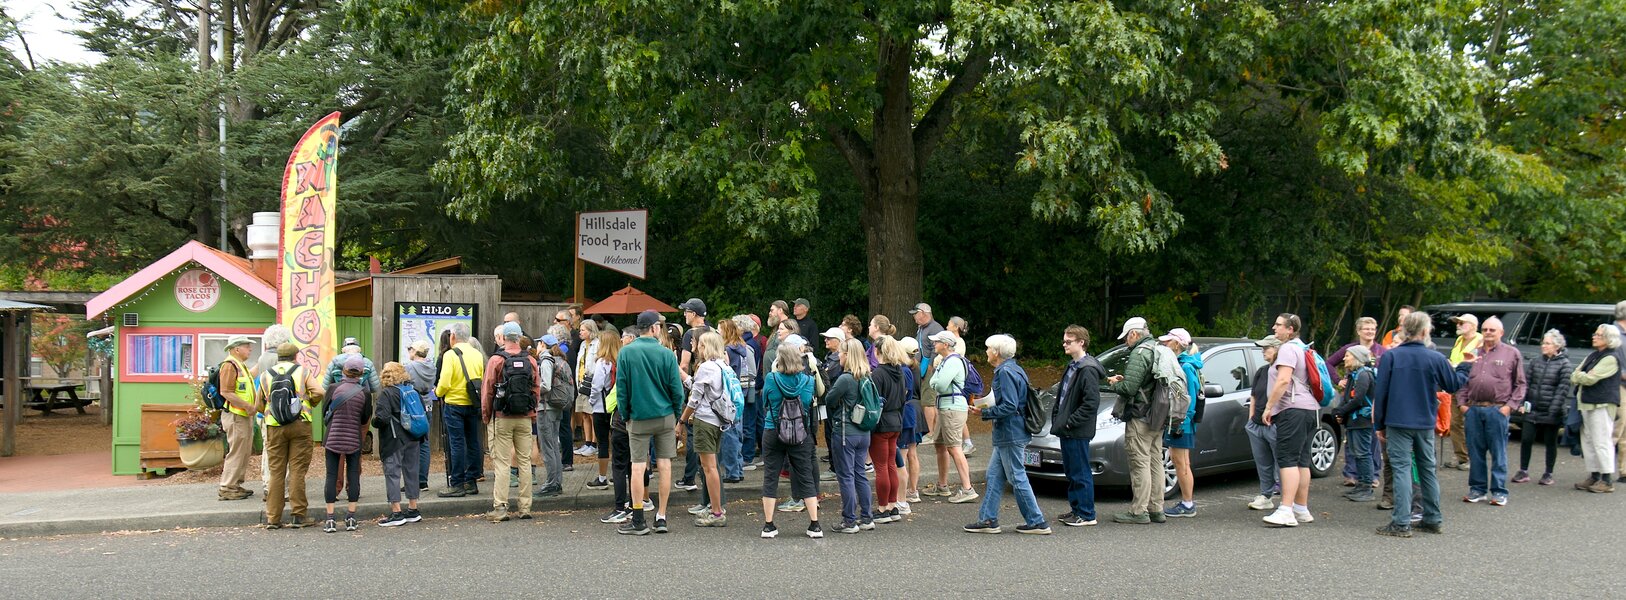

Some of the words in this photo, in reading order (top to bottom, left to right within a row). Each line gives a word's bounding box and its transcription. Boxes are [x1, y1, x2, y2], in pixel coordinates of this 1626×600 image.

[585, 217, 636, 230] Hillsdale
[581, 233, 609, 246] Food
[613, 238, 642, 251] Park
[603, 256, 642, 265] Welcome!
[290, 161, 327, 378] NACHOS
